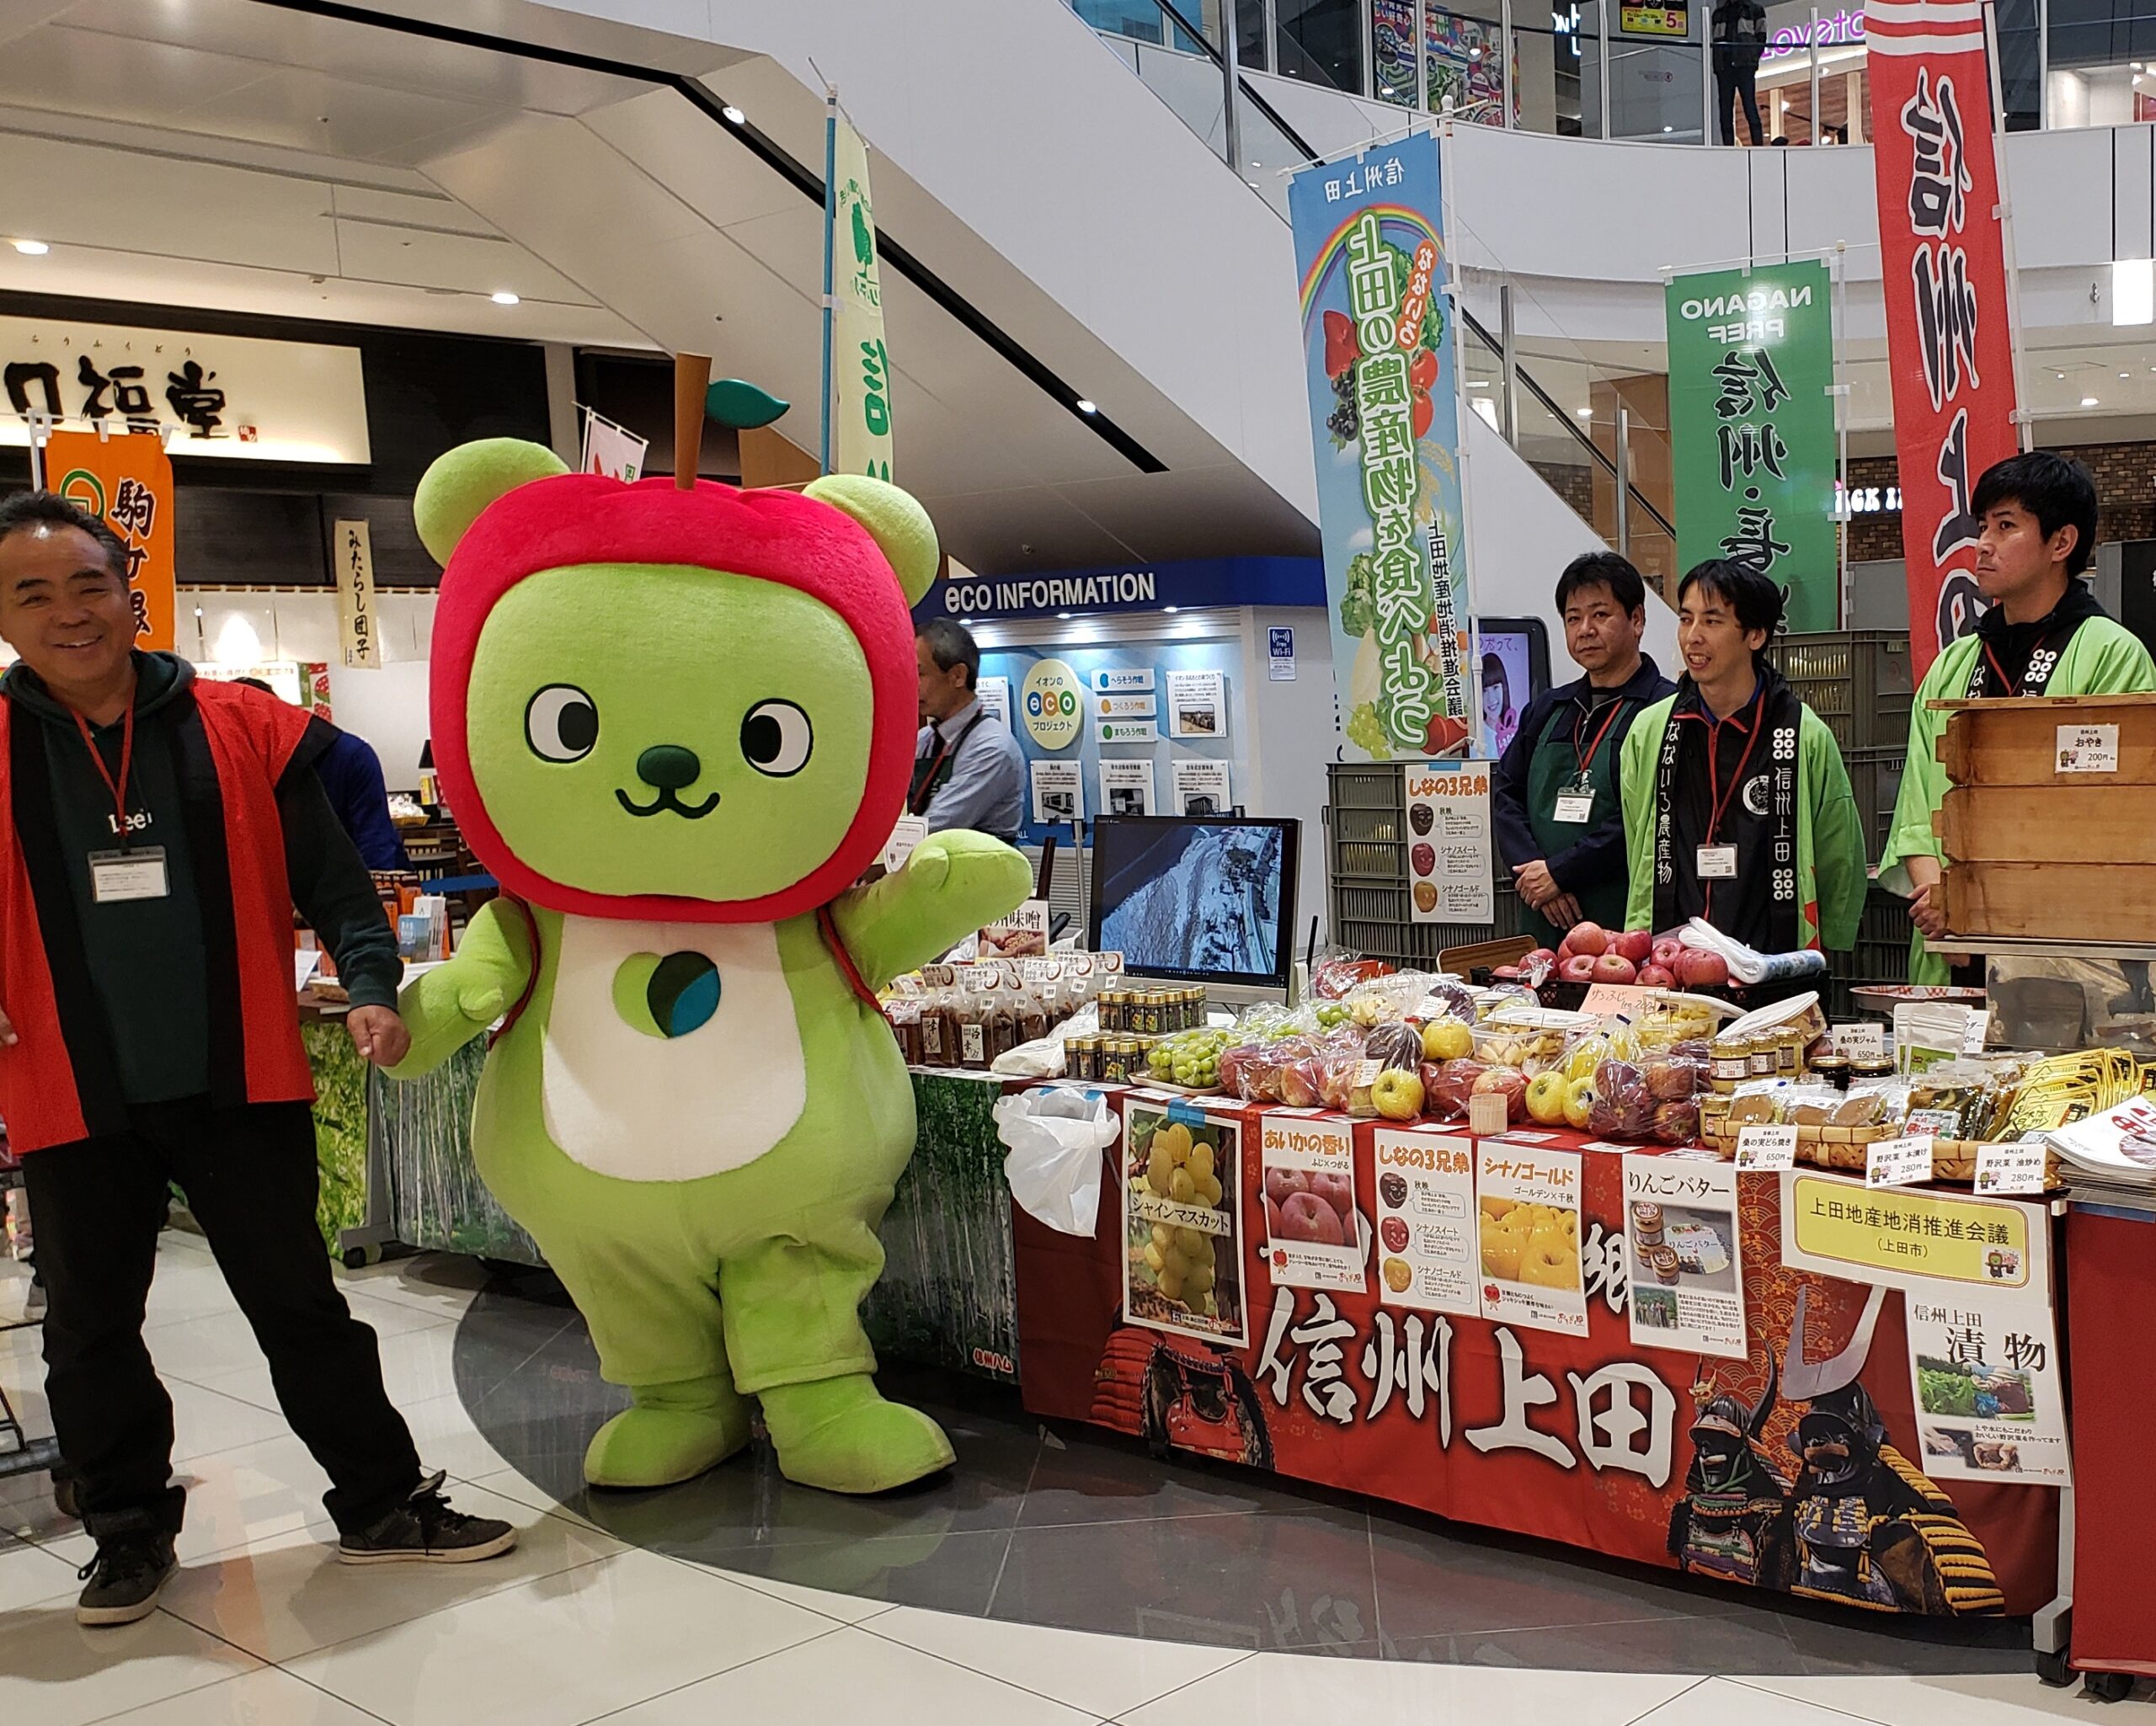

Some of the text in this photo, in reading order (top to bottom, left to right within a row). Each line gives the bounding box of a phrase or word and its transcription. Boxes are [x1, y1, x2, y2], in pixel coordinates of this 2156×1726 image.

[4, 355, 229, 439] 口福堂
[348, 529, 371, 661] みたらし団子
[995, 573, 1156, 610] INFORMATION
[1272, 647, 1291, 656] Wi-Fi
[1035, 676, 1064, 686] イオンの
[1111, 676, 1145, 685] へらそう作戦
[1113, 701, 1146, 711] つくろう作戦
[1033, 721, 1073, 732] プロジェクト
[1114, 727, 1148, 737] まもろう作戦
[2074, 737, 2103, 748] おやき
[2088, 753, 2109, 761] 200円
[1408, 775, 1489, 797] しなの3兄弟
[1656, 721, 1682, 886] なないろ農産物
[1773, 767, 1793, 863] 信州上田
[109, 811, 147, 834] Lee
[1441, 845, 1478, 855] シナノスイート
[1442, 885, 1481, 893] シナノゴールド
[1840, 1035, 1877, 1045] 桑の実ジャム
[1857, 1050, 1876, 1058] 650円
[1263, 1129, 1351, 1157] あいかの香り
[1742, 1137, 1791, 1147] 桑の実どら焼き
[1379, 1144, 1470, 1175] しなの3兄弟
[1876, 1148, 1928, 1163] 野沢菜 本漬け
[1311, 1158, 1350, 1170] ふじ×つがる
[1901, 1164, 1923, 1174] 280円
[1986, 1158, 2041, 1168] 野沢菜 油炒め
[1483, 1157, 1575, 1187] シナノゴールド
[2011, 1174, 2035, 1182] 280円
[1414, 1180, 1429, 1191] 秋映
[1628, 1171, 1731, 1199] りんごバター
[1513, 1185, 1575, 1204] ゴールデン×千秋
[1132, 1198, 1230, 1233] シャインマスカット
[1809, 1198, 2009, 1246] 上田地産地消推進会議
[1416, 1223, 1459, 1237] シナノスイート
[1668, 1239, 1719, 1249] りんごバター
[1417, 1265, 1462, 1279] シナノゴールド
[1913, 1304, 1983, 1328] 信州上田
[1945, 1327, 2047, 1372] 漬物
[1256, 1286, 1676, 1489] 信州上田
[1975, 1433, 2062, 1444] おいしい野沢菜を作ってます
